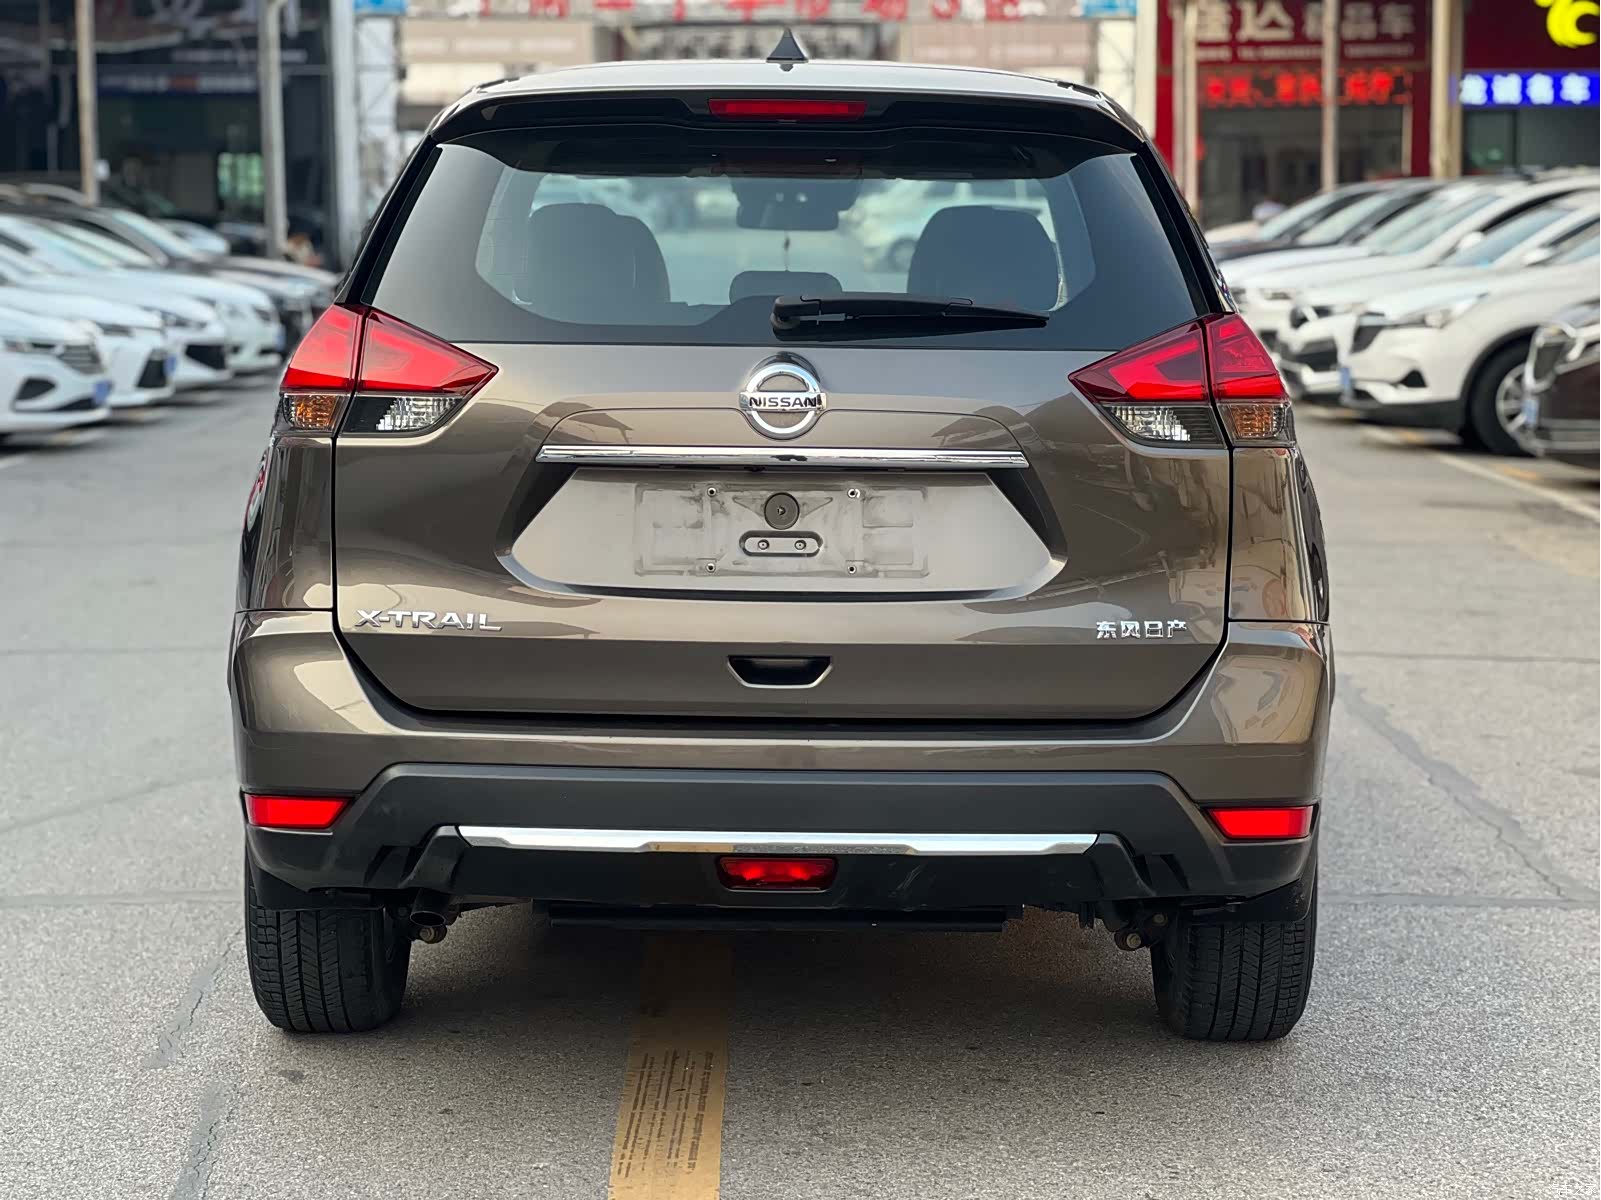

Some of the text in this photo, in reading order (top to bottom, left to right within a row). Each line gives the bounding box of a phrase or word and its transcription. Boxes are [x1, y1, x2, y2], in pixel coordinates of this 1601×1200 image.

[748, 396, 817, 408] NISSAN
[354, 609, 503, 632] X-TRAIL
[1096, 618, 1188, 640] 东风日产
